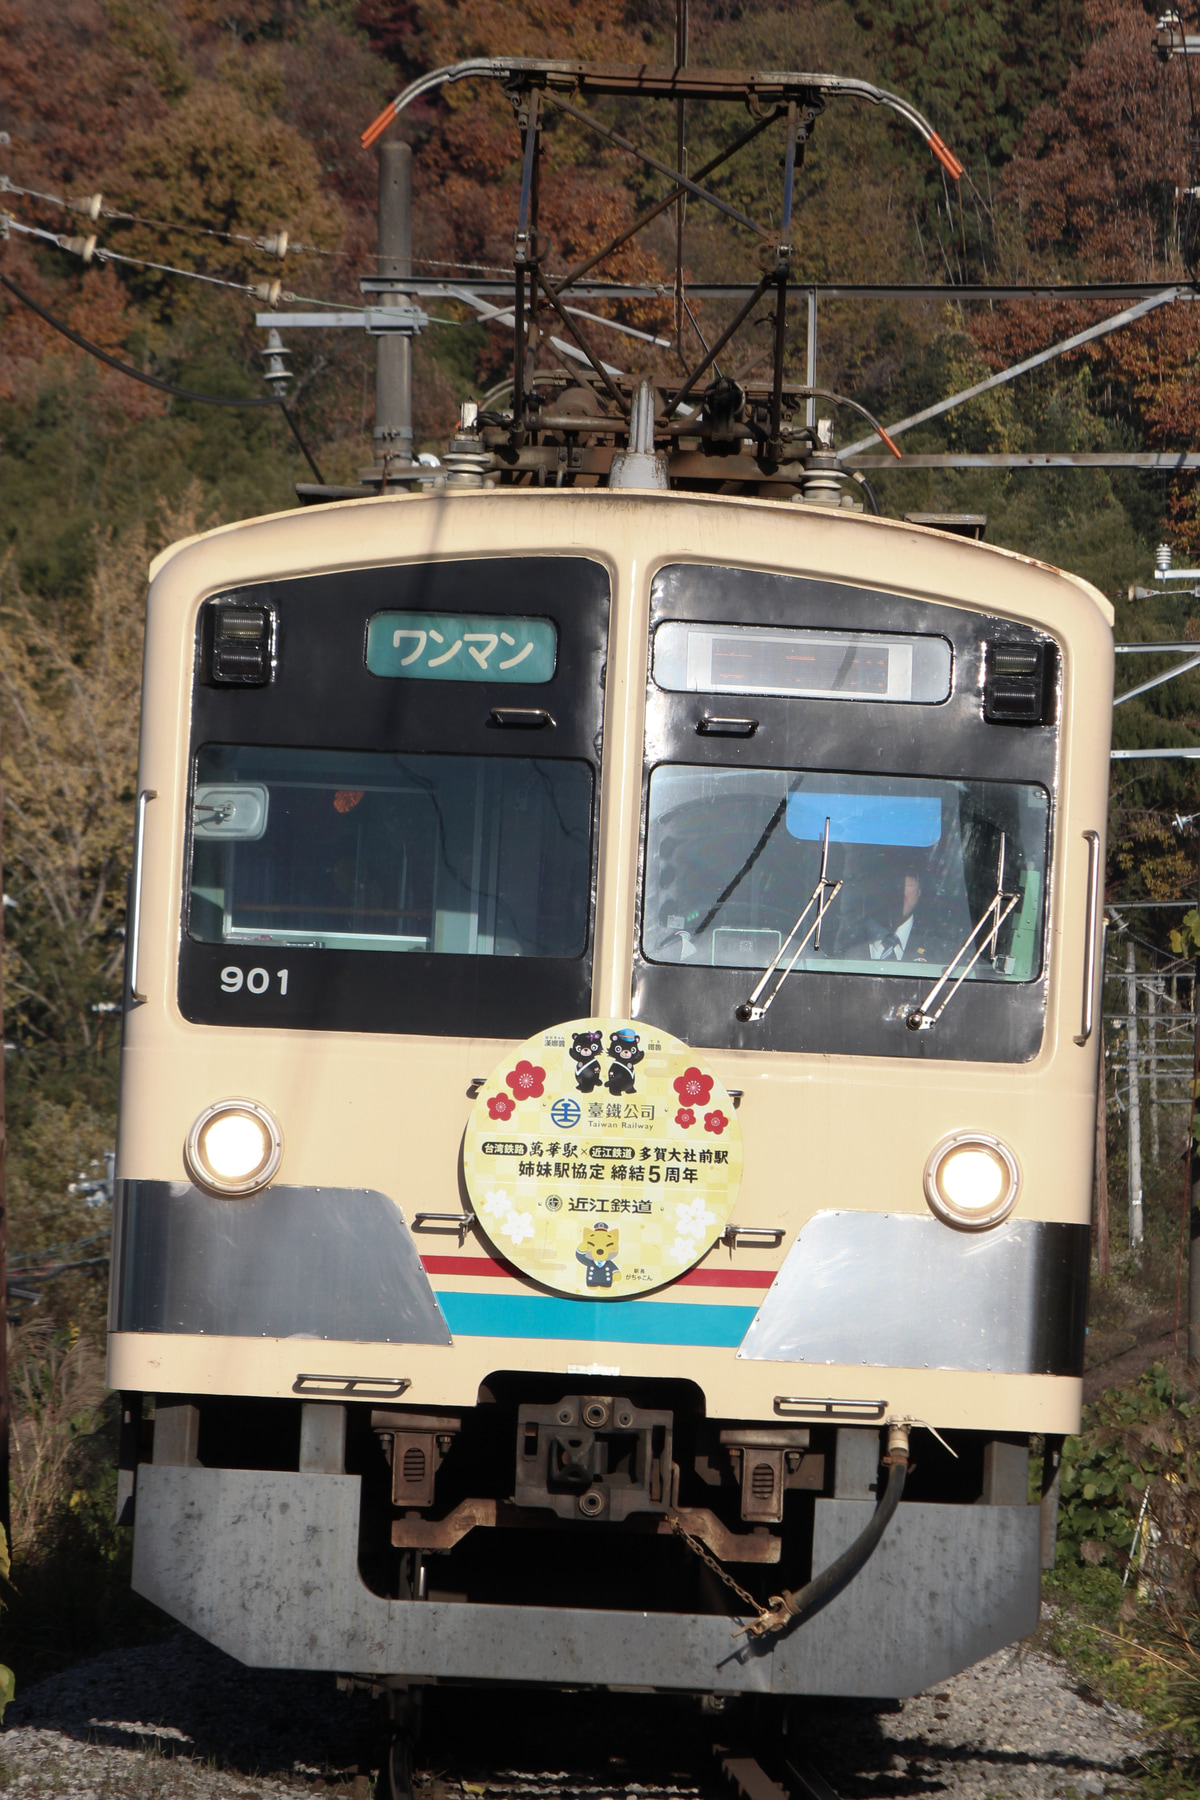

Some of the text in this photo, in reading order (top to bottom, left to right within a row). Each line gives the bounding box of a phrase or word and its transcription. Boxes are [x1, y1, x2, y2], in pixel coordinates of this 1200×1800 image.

[393, 629, 534, 669] ワンマン
[220, 966, 289, 995] 901
[588, 1102, 655, 1120] 臺鐵公司
[588, 1120, 654, 1131] Taiwan Railway
[639, 1146, 729, 1164] 多賀大社前駅
[518, 1160, 605, 1180] 姉妹駅協定
[568, 1197, 653, 1214] 近江鉄道
